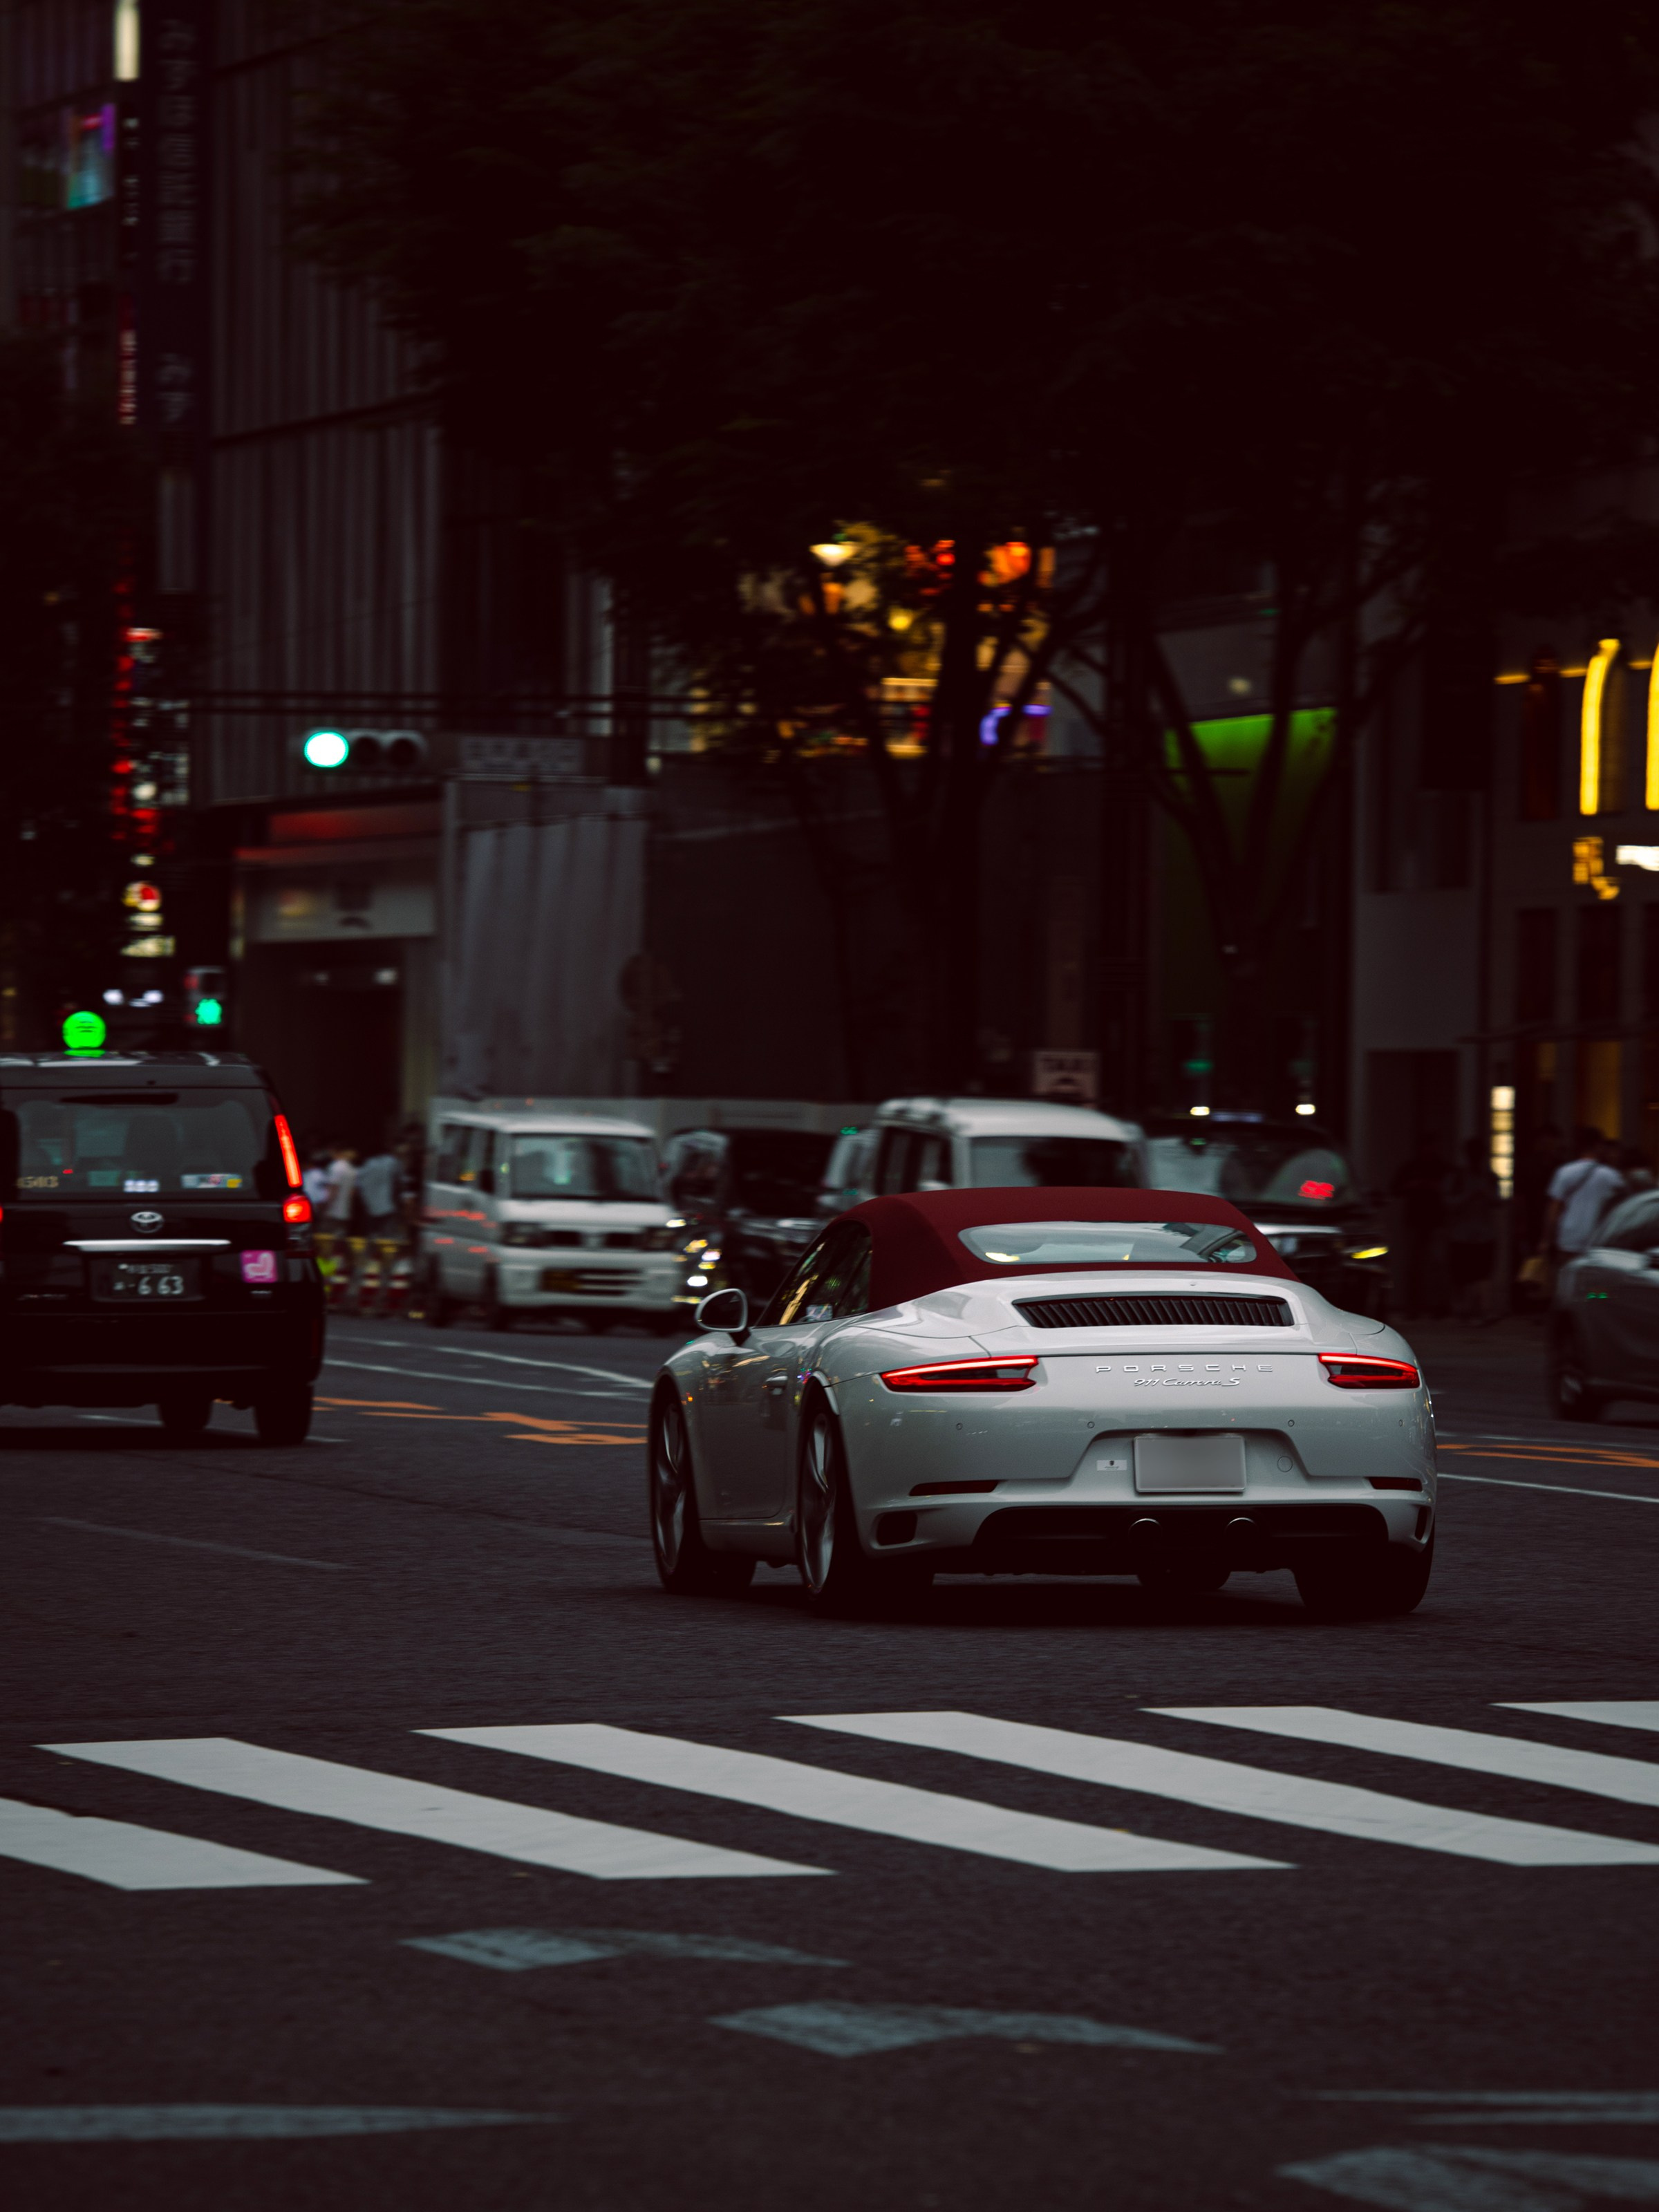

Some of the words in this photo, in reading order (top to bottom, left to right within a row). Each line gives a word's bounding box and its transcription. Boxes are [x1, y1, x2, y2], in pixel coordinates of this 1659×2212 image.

[1095, 1364, 1274, 1374] PORSCHE
[1134, 1378, 1161, 1387] 911
[1162, 1377, 1221, 1387] Carrera
[1221, 1377, 1241, 1387] S
